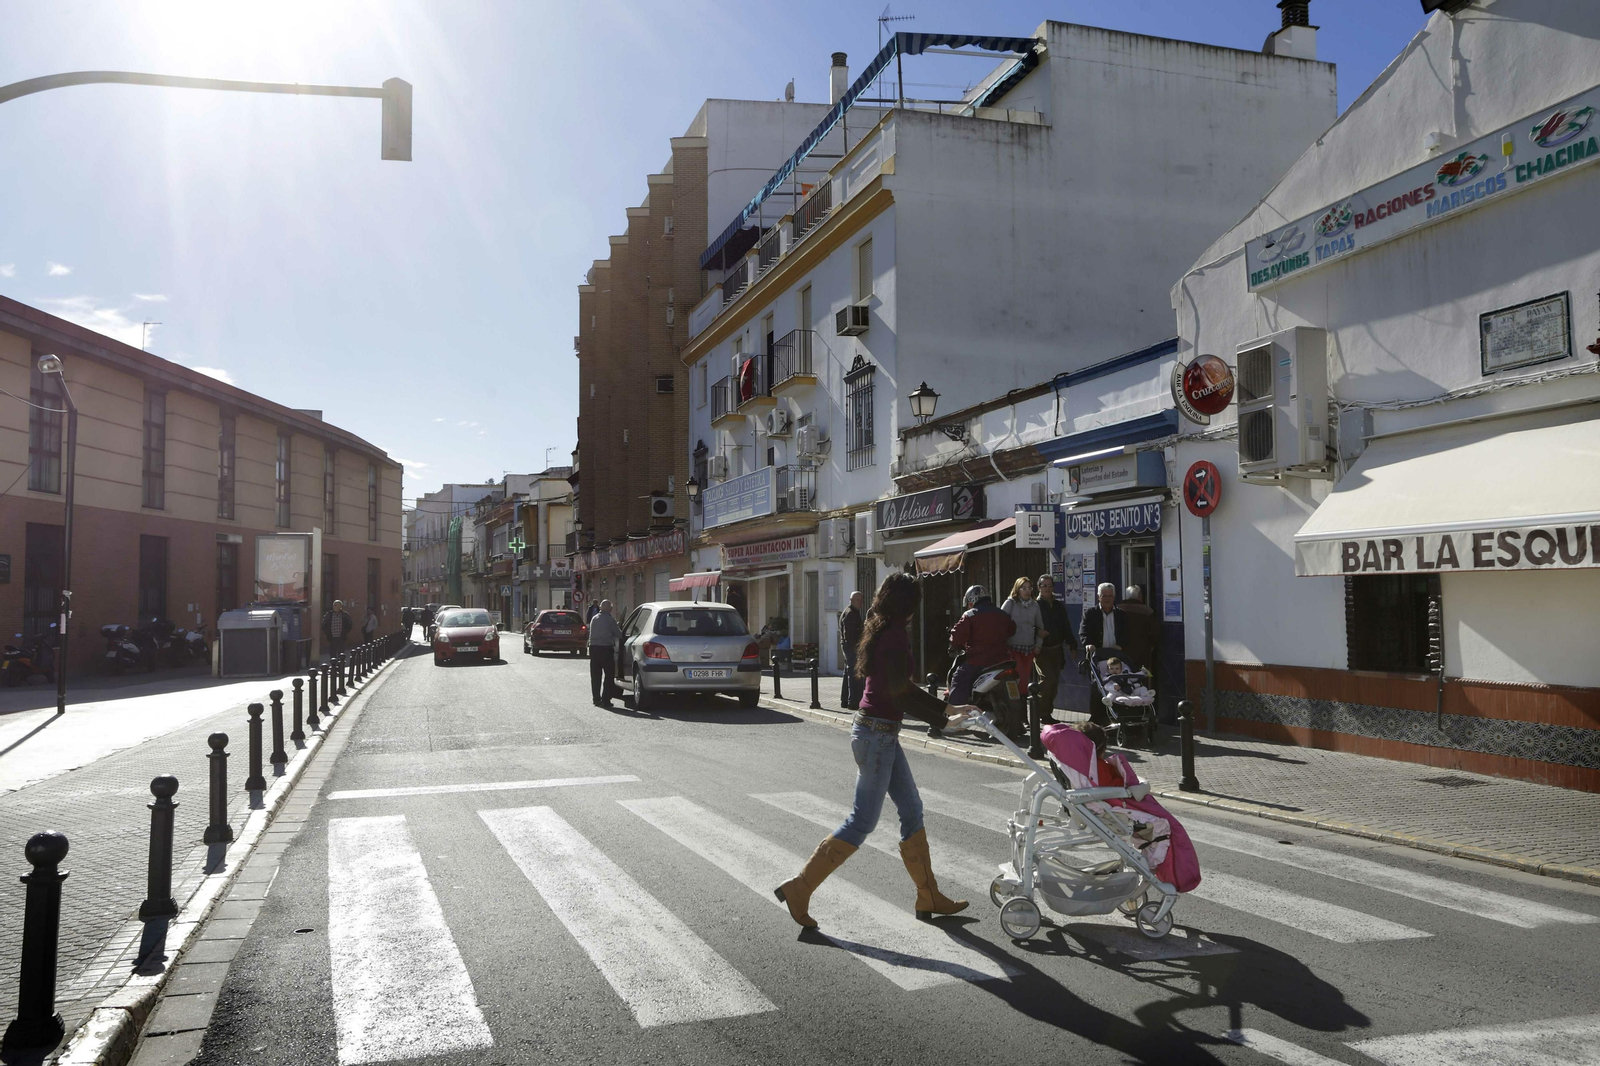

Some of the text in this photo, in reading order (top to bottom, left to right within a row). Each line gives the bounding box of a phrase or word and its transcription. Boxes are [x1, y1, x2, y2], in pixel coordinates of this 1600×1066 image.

[1251, 251, 1310, 287] DESAYUNOS
[1315, 232, 1355, 261] TAPAS
[1426, 172, 1507, 219] MARISCOS
[1191, 376, 1232, 400] Cruzcampo
[1181, 400, 1202, 421] ESQUINA
[1081, 468, 1129, 485] Apuestas del Estado
[1067, 511, 1106, 533] LOTERIAS
[1109, 506, 1141, 529] BENITO
[728, 547, 744, 558] SUPER
[745, 539, 792, 556] ALIMENTACION
[793, 536, 805, 550] JIN
[1341, 538, 1406, 573] BAR
[1415, 534, 1460, 570] LA
